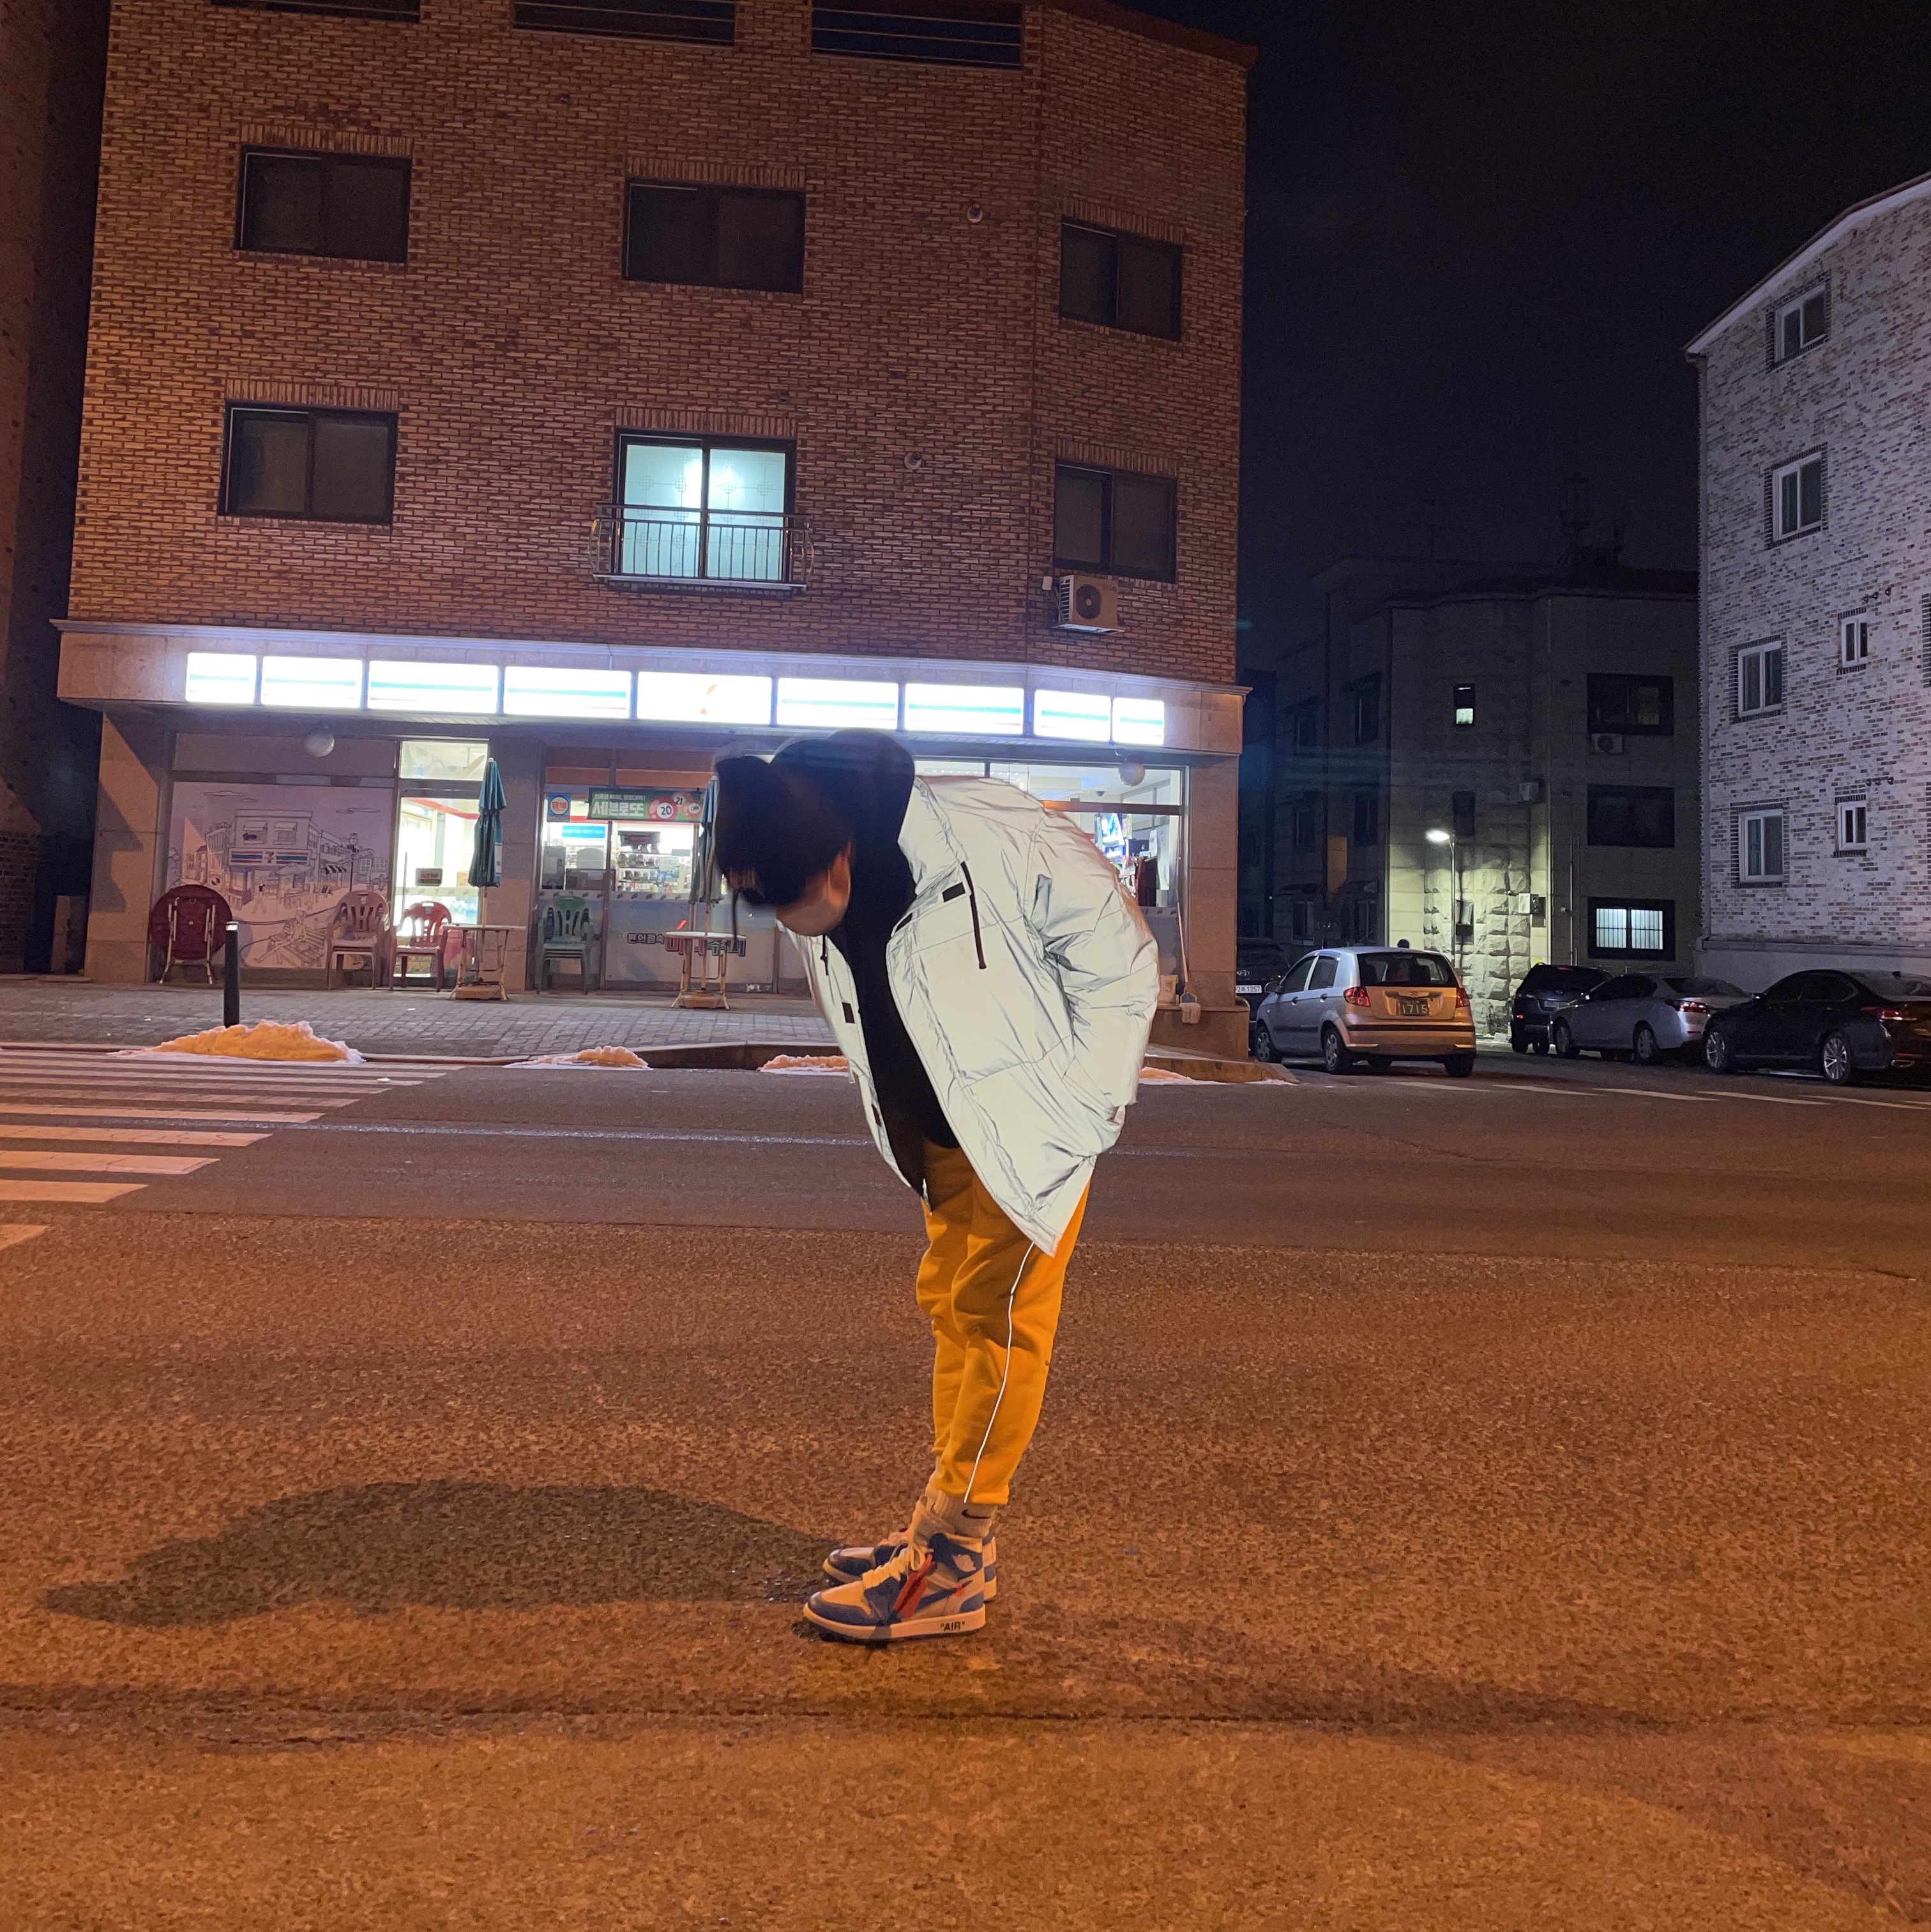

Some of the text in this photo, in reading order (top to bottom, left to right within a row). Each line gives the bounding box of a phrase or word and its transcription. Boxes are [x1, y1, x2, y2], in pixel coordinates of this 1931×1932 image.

[676, 797, 683, 805] 21
[593, 801, 644, 817] 세븐로또
[660, 806, 672, 816] 20
[628, 933, 665, 945] 편의점속
[1402, 1004, 1428, 1014] 1715
[940, 1621, 965, 1632] "AIR"
